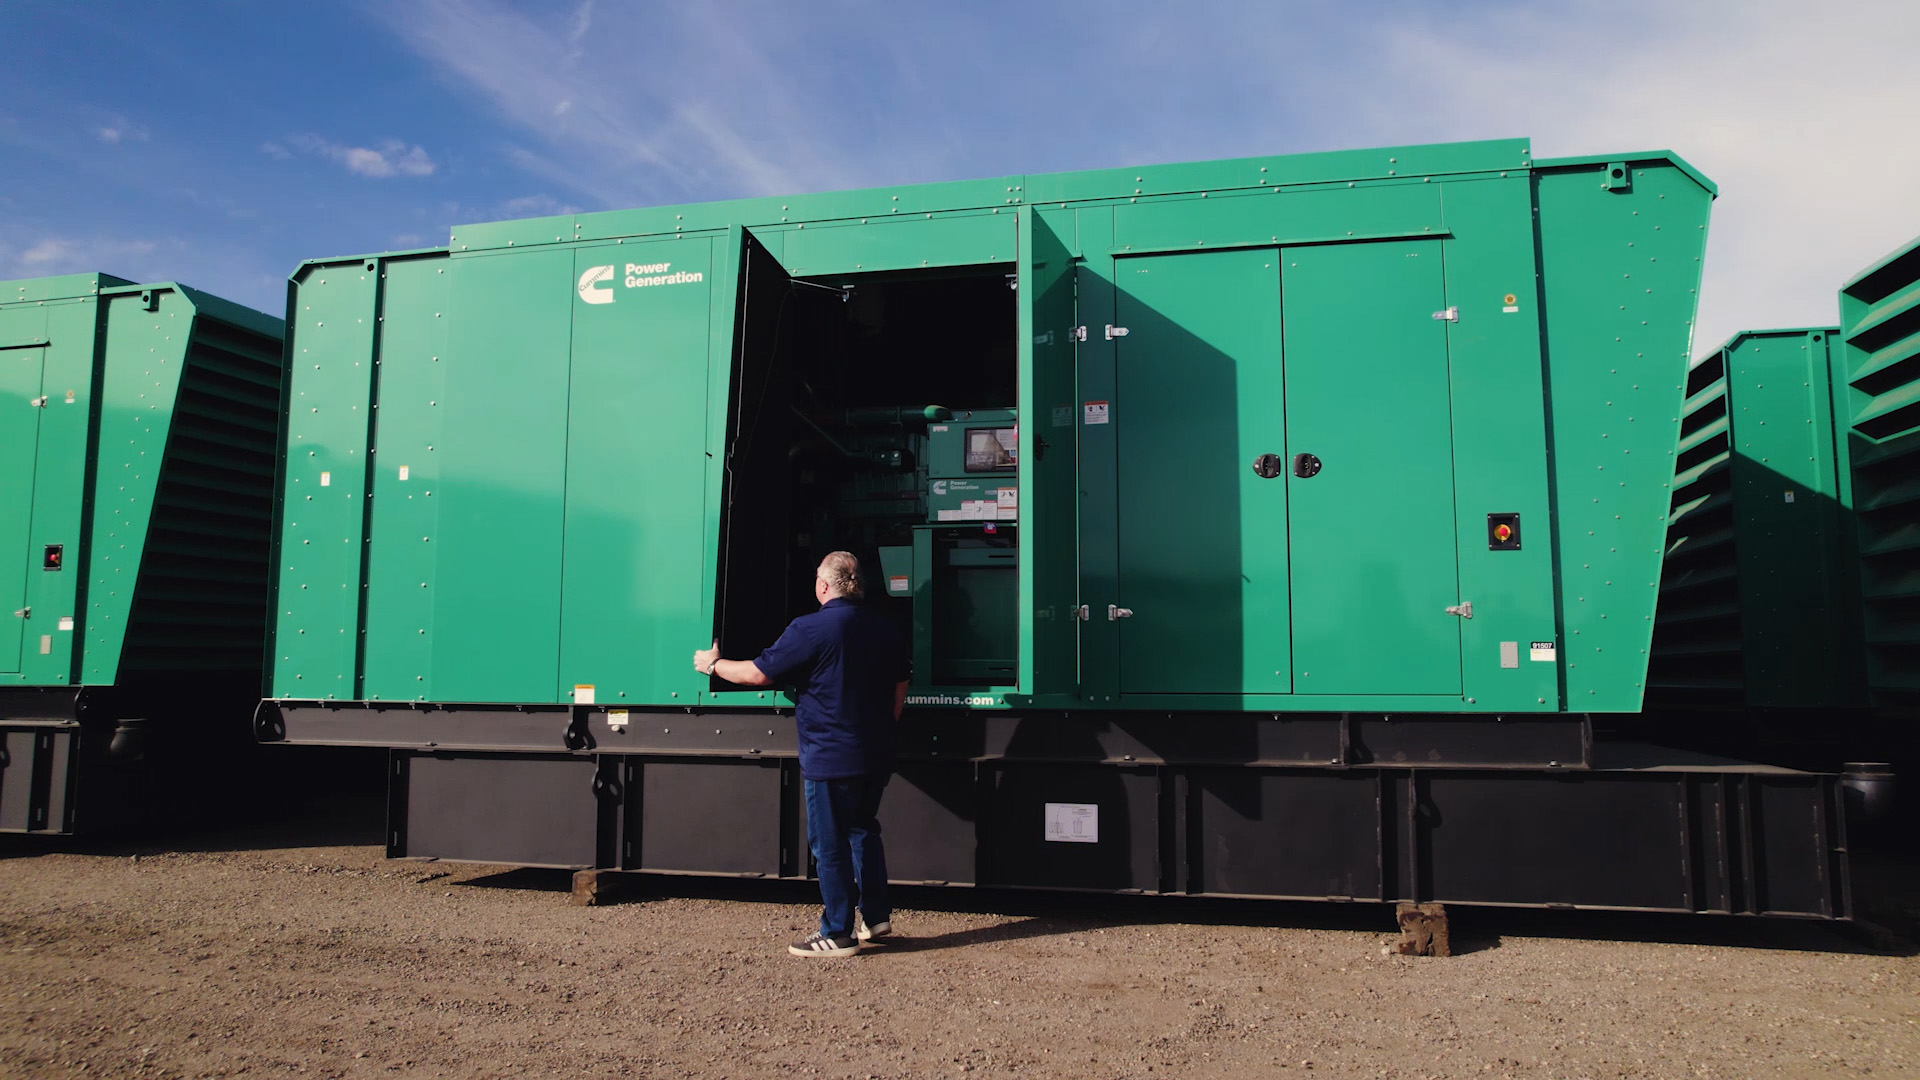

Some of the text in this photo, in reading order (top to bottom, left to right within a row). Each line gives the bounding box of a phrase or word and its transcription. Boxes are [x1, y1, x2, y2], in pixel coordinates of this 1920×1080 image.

[625, 262, 671, 275] Power
[579, 266, 611, 292] Cummins
[624, 271, 703, 288] Generation
[904, 694, 994, 706] ummins.com
